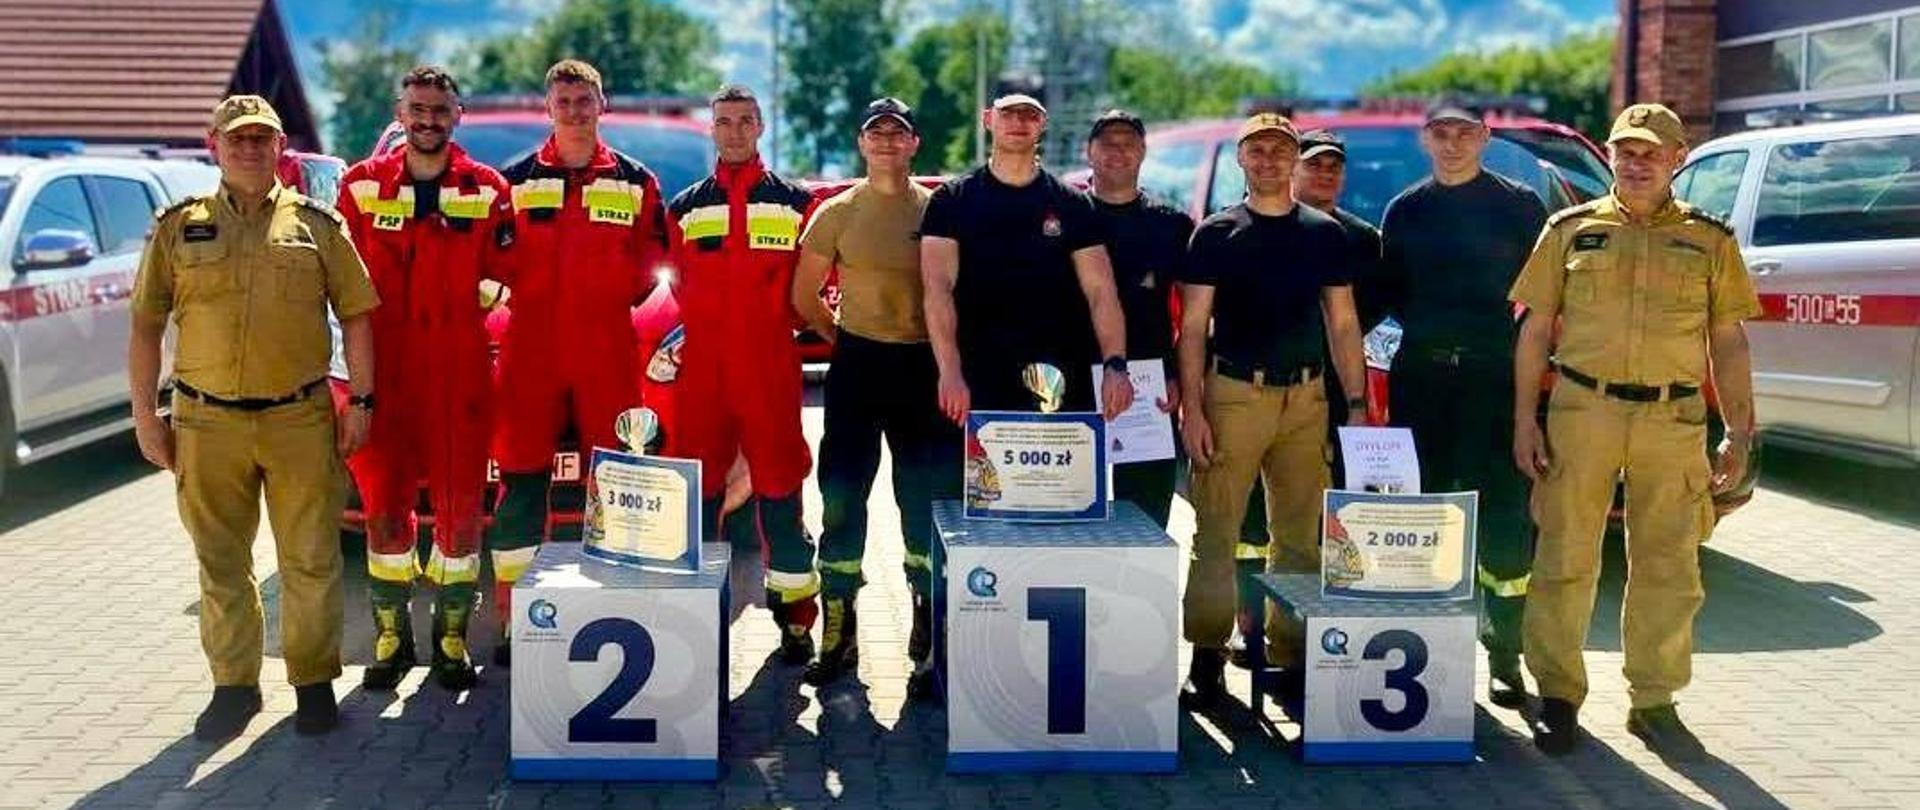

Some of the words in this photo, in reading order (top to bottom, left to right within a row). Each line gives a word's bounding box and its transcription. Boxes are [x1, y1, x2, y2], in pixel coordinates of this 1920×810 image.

[379, 215, 400, 227] PSP
[1004, 450, 1014, 464] 5
[1019, 451, 1051, 465] 000
[1055, 450, 1071, 465] zł
[608, 490, 616, 505] 3
[619, 493, 643, 509] 000
[647, 496, 662, 512] zł
[1367, 532, 1378, 546] 2
[1384, 532, 1418, 547] 000
[1422, 531, 1439, 547] zł
[1027, 587, 1086, 734] 1
[568, 616, 657, 743] 2
[1360, 629, 1429, 732] 3
